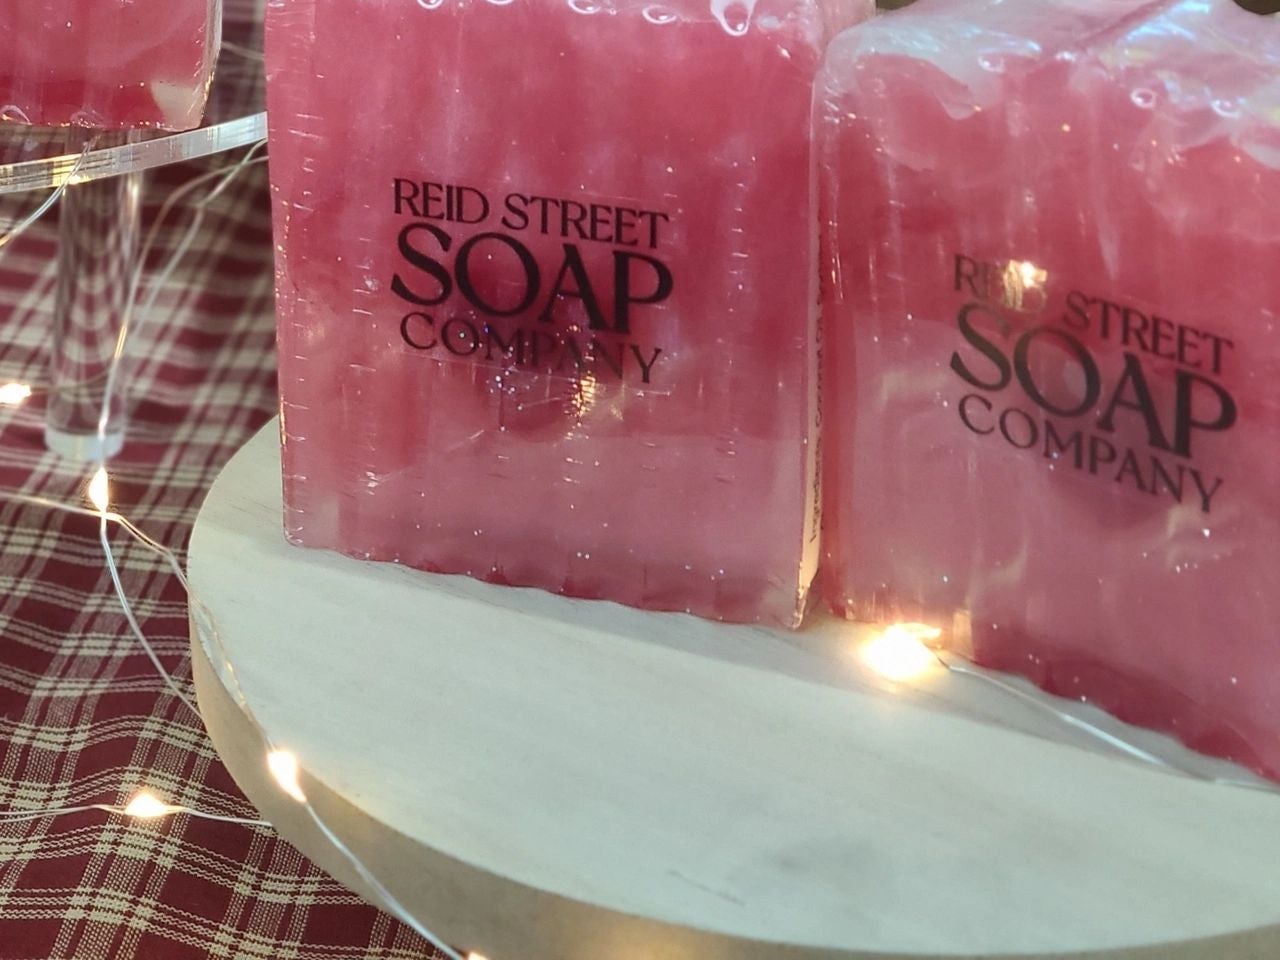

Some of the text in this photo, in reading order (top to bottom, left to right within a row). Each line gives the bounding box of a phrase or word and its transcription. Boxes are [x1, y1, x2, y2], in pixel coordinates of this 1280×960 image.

[393, 178, 669, 249] REID STREET
[390, 222, 673, 335] SOAP
[400, 312, 662, 383] COMPANY
[949, 302, 1237, 459] SOAP
[1064, 290, 1234, 374] STREET
[958, 393, 1223, 513] COMPANY
